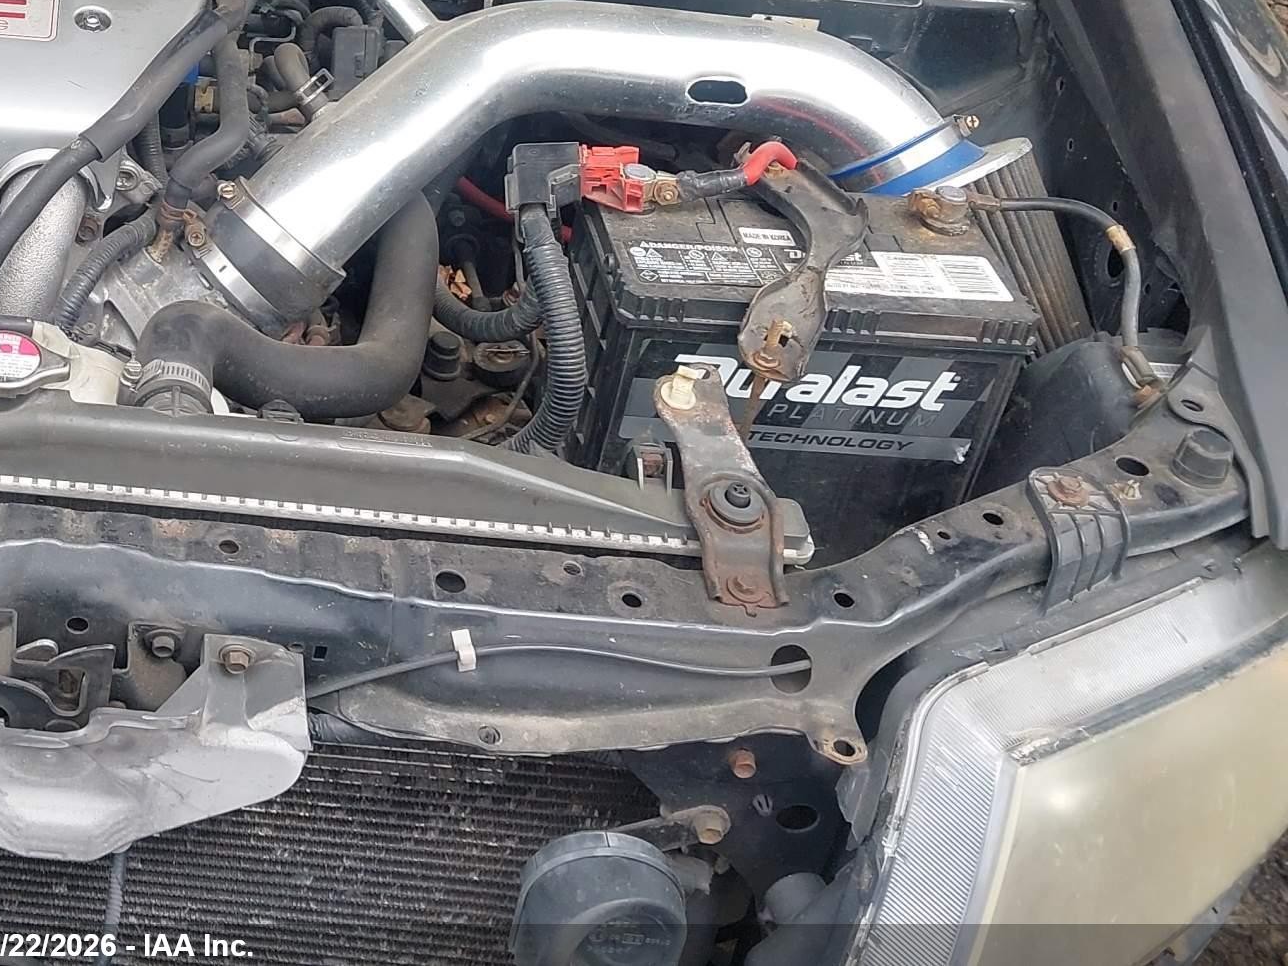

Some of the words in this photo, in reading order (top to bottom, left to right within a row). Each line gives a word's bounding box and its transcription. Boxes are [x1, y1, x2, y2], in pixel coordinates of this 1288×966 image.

[648, 242, 738, 252] DANGER/POISON
[767, 403, 938, 428] PLATINUM
[747, 430, 914, 452] TECHNOLOGY
